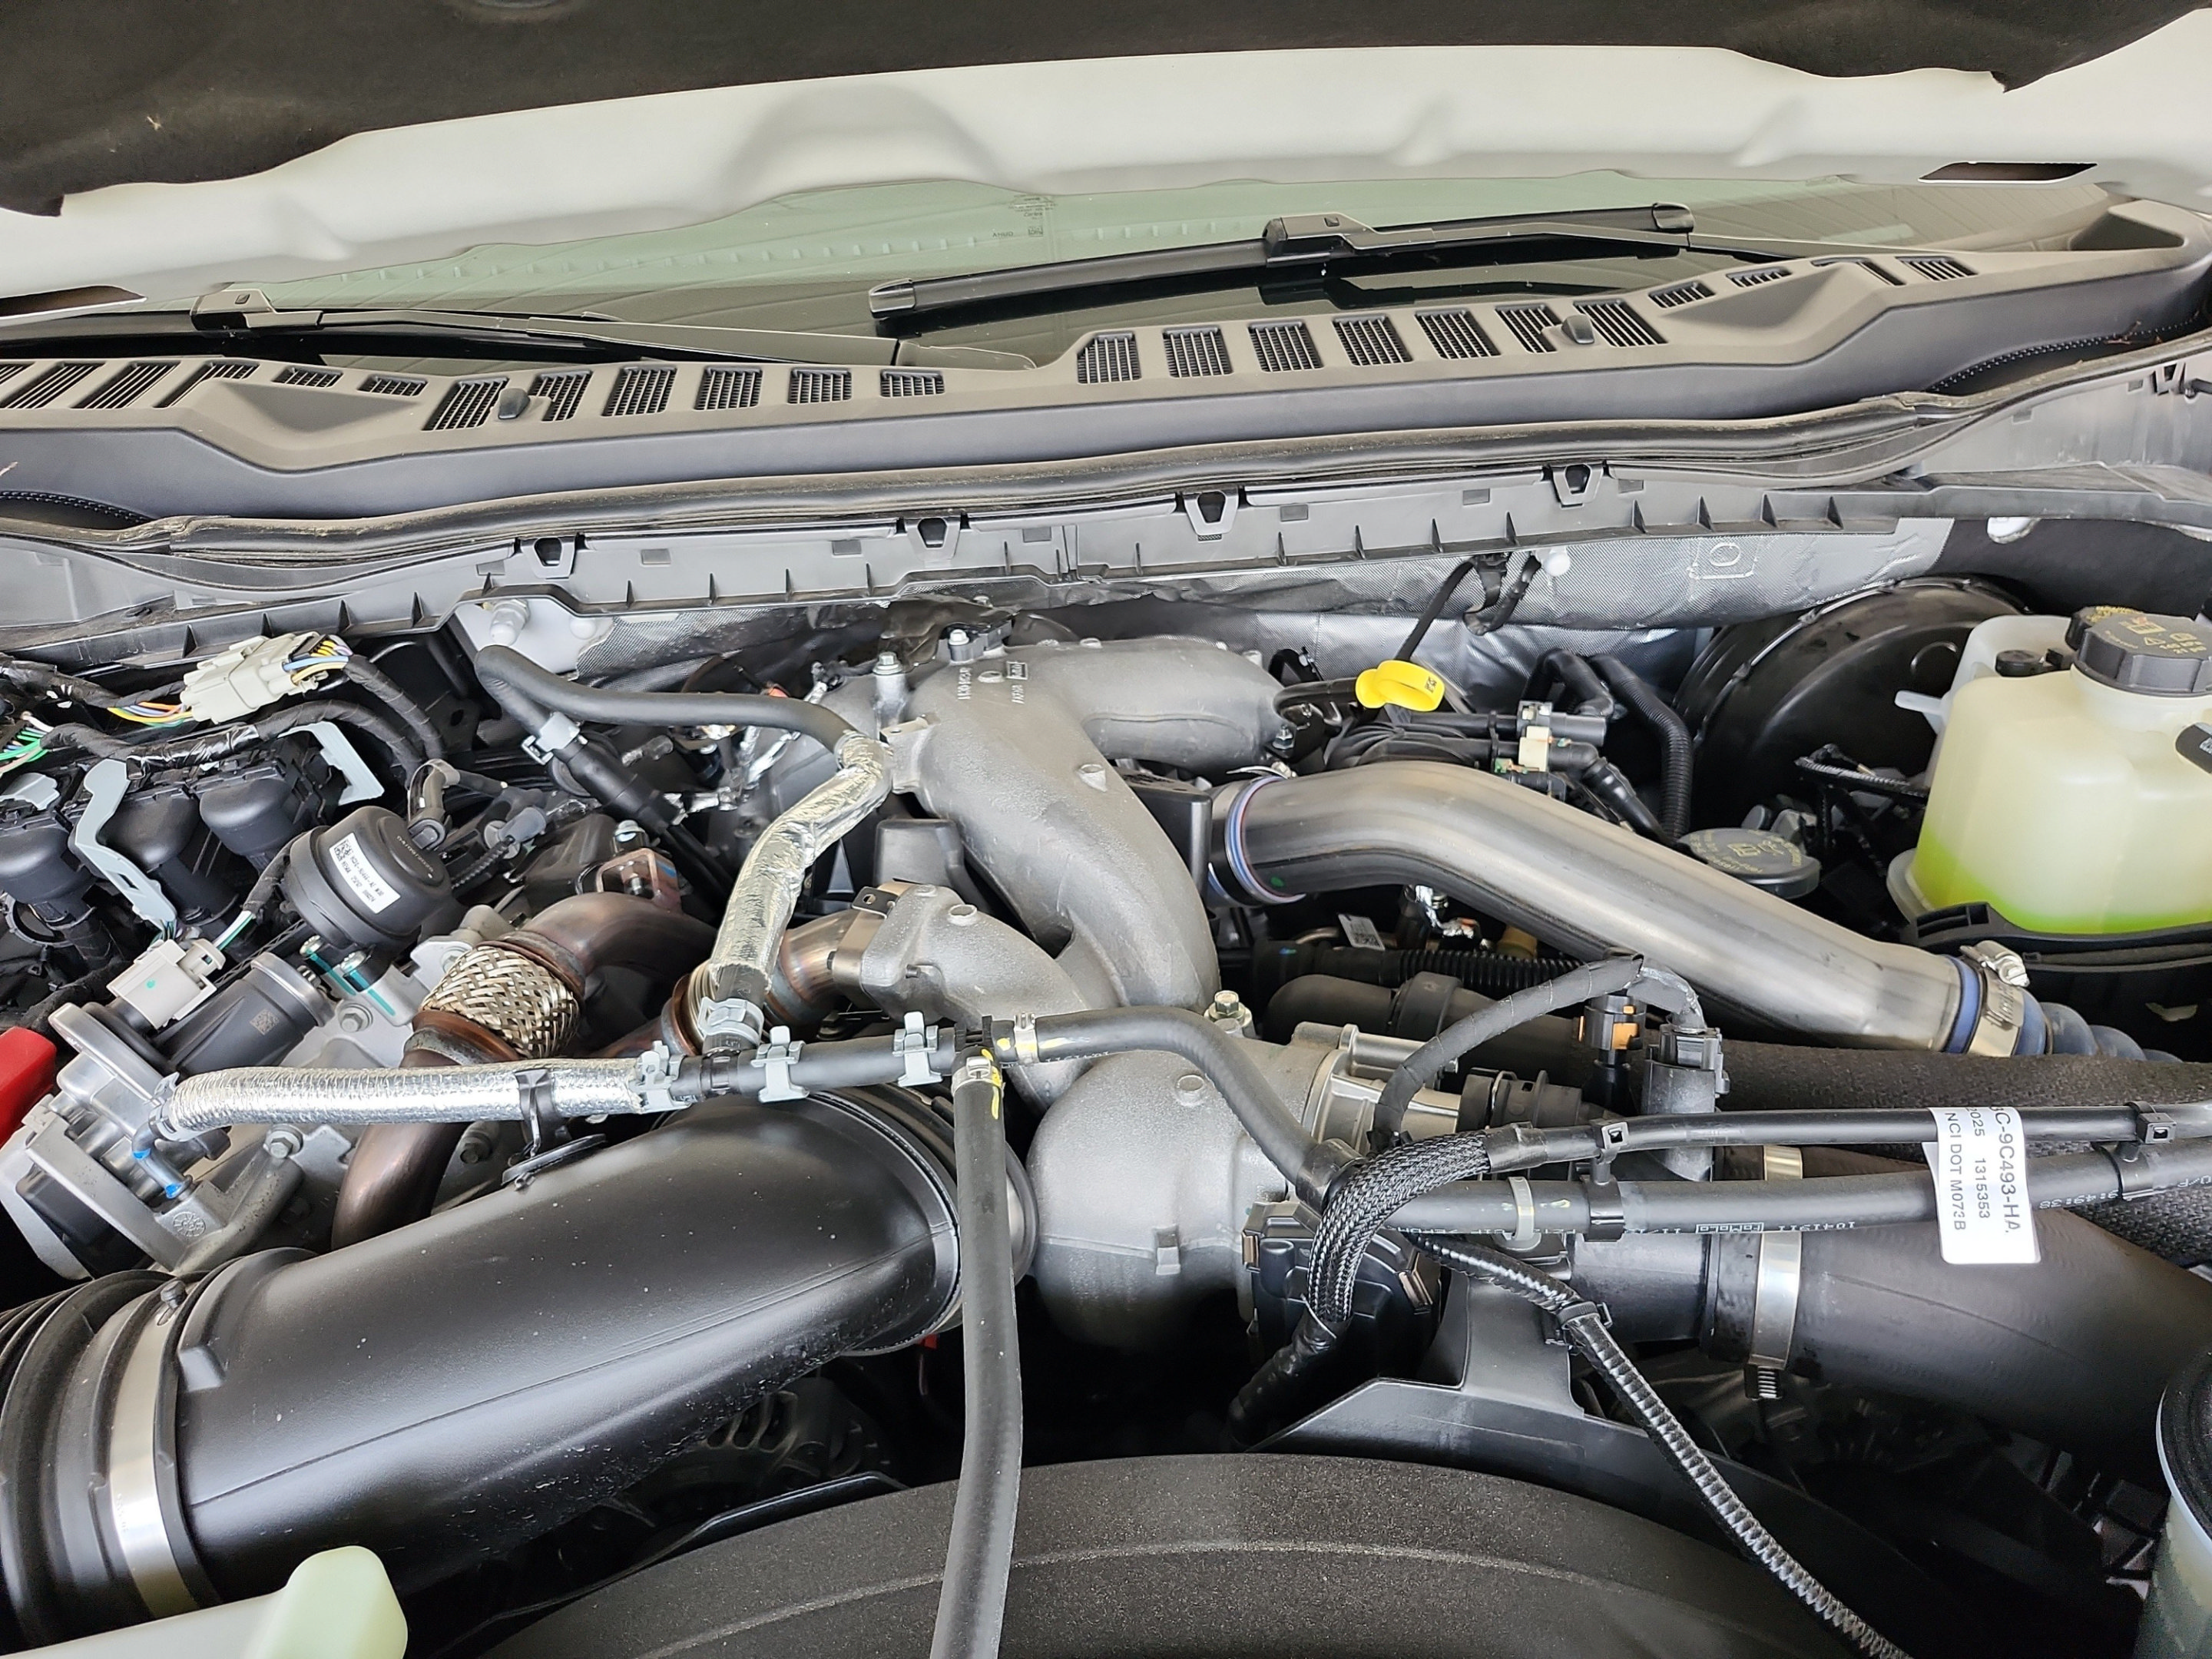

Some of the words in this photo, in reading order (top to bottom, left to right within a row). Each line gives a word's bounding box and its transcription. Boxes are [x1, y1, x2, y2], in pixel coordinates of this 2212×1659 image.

[1945, 1112, 1962, 1137] NCI
[1949, 1144, 1962, 1174] DOT
[1975, 1157, 1991, 1219] 1315353
